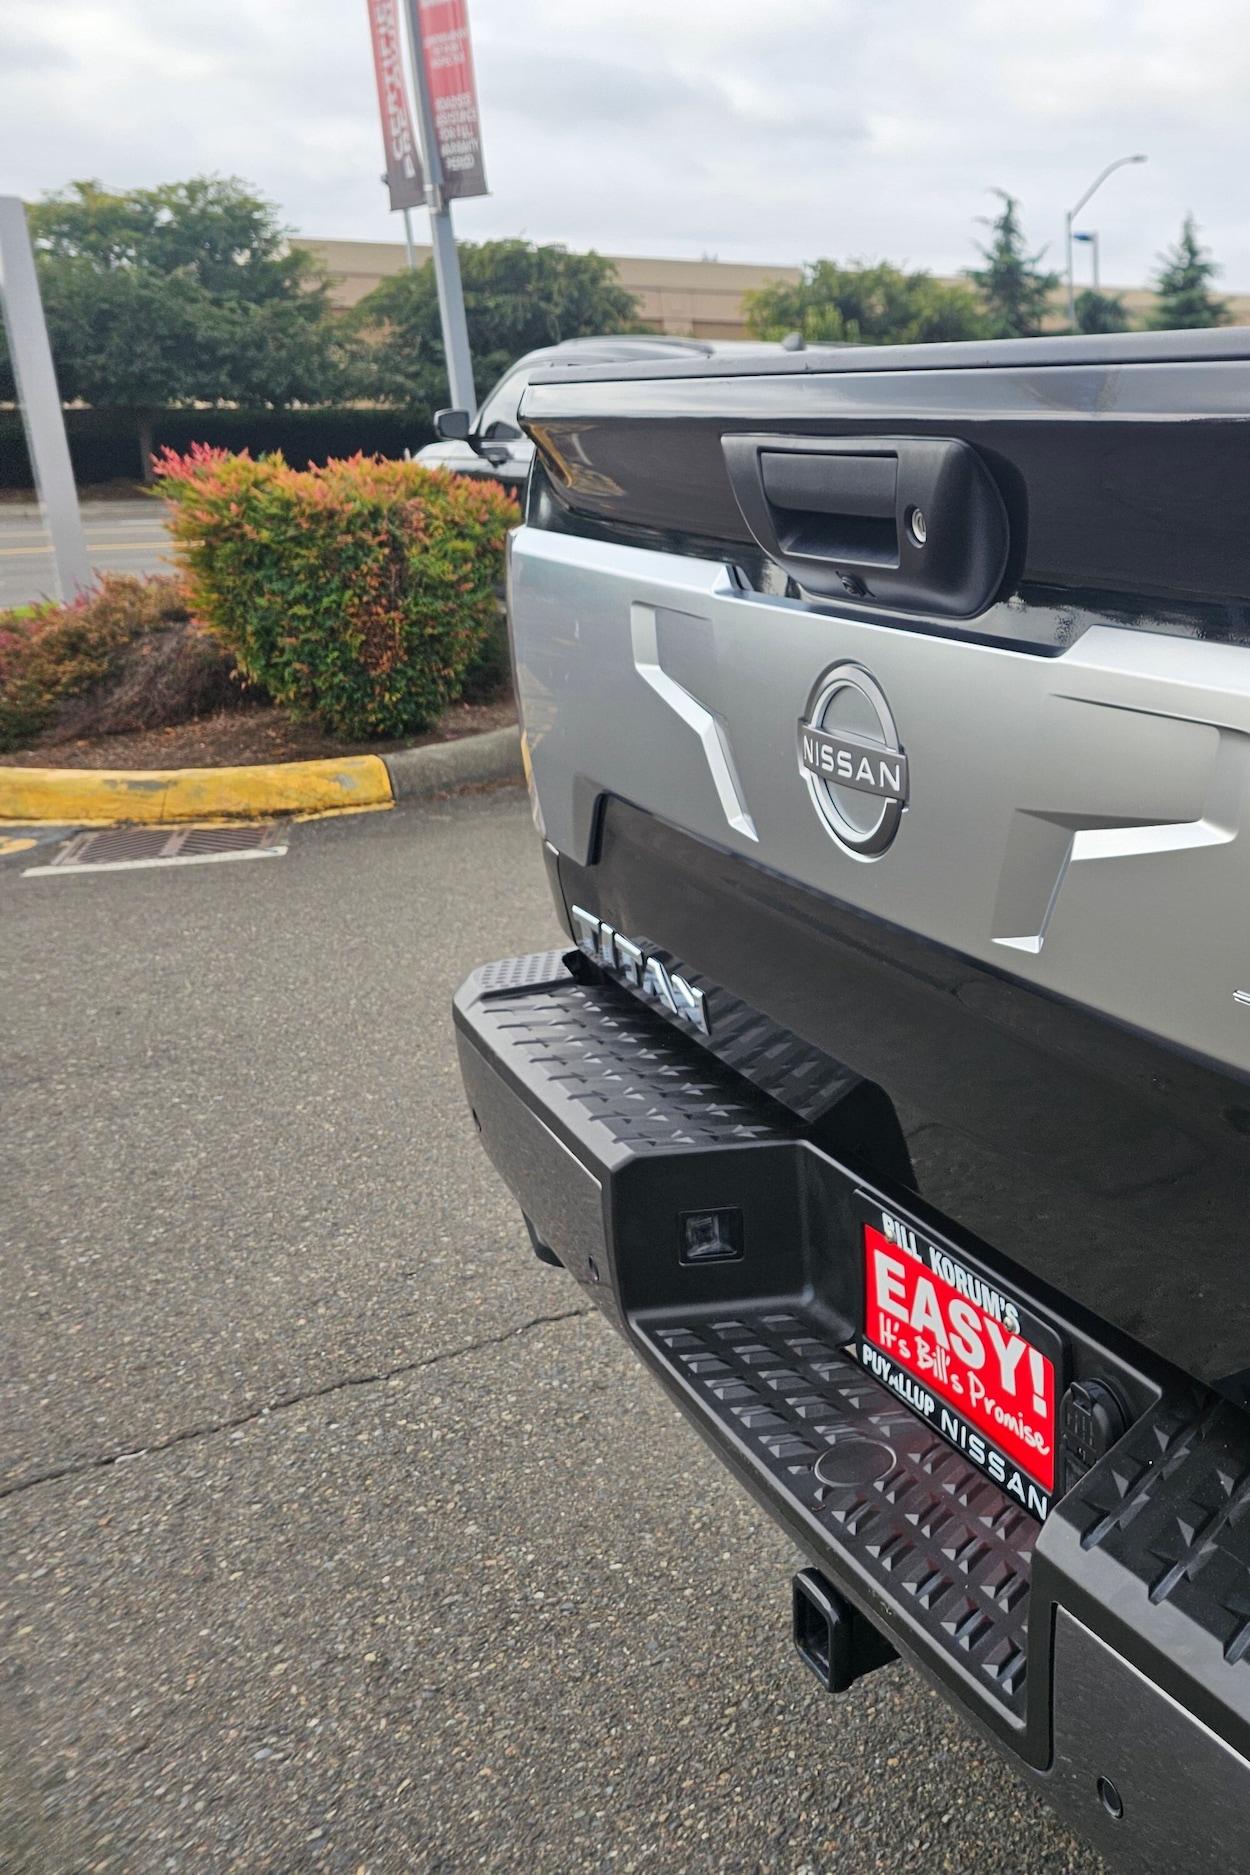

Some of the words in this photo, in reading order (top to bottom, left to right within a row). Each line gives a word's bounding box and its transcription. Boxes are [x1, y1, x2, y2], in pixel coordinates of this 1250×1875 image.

[803, 735, 900, 792] NISSAN
[571, 904, 711, 1036] TITAN
[873, 1249, 1047, 1418] EASY!
[881, 1212, 922, 1264] BILL
[929, 1246, 1021, 1335] KORUM'S
[878, 1312, 911, 1359] It's
[915, 1335, 964, 1395] Bill's
[968, 1371, 1050, 1456] Promise
[941, 1408, 1048, 1521] NISSAN
